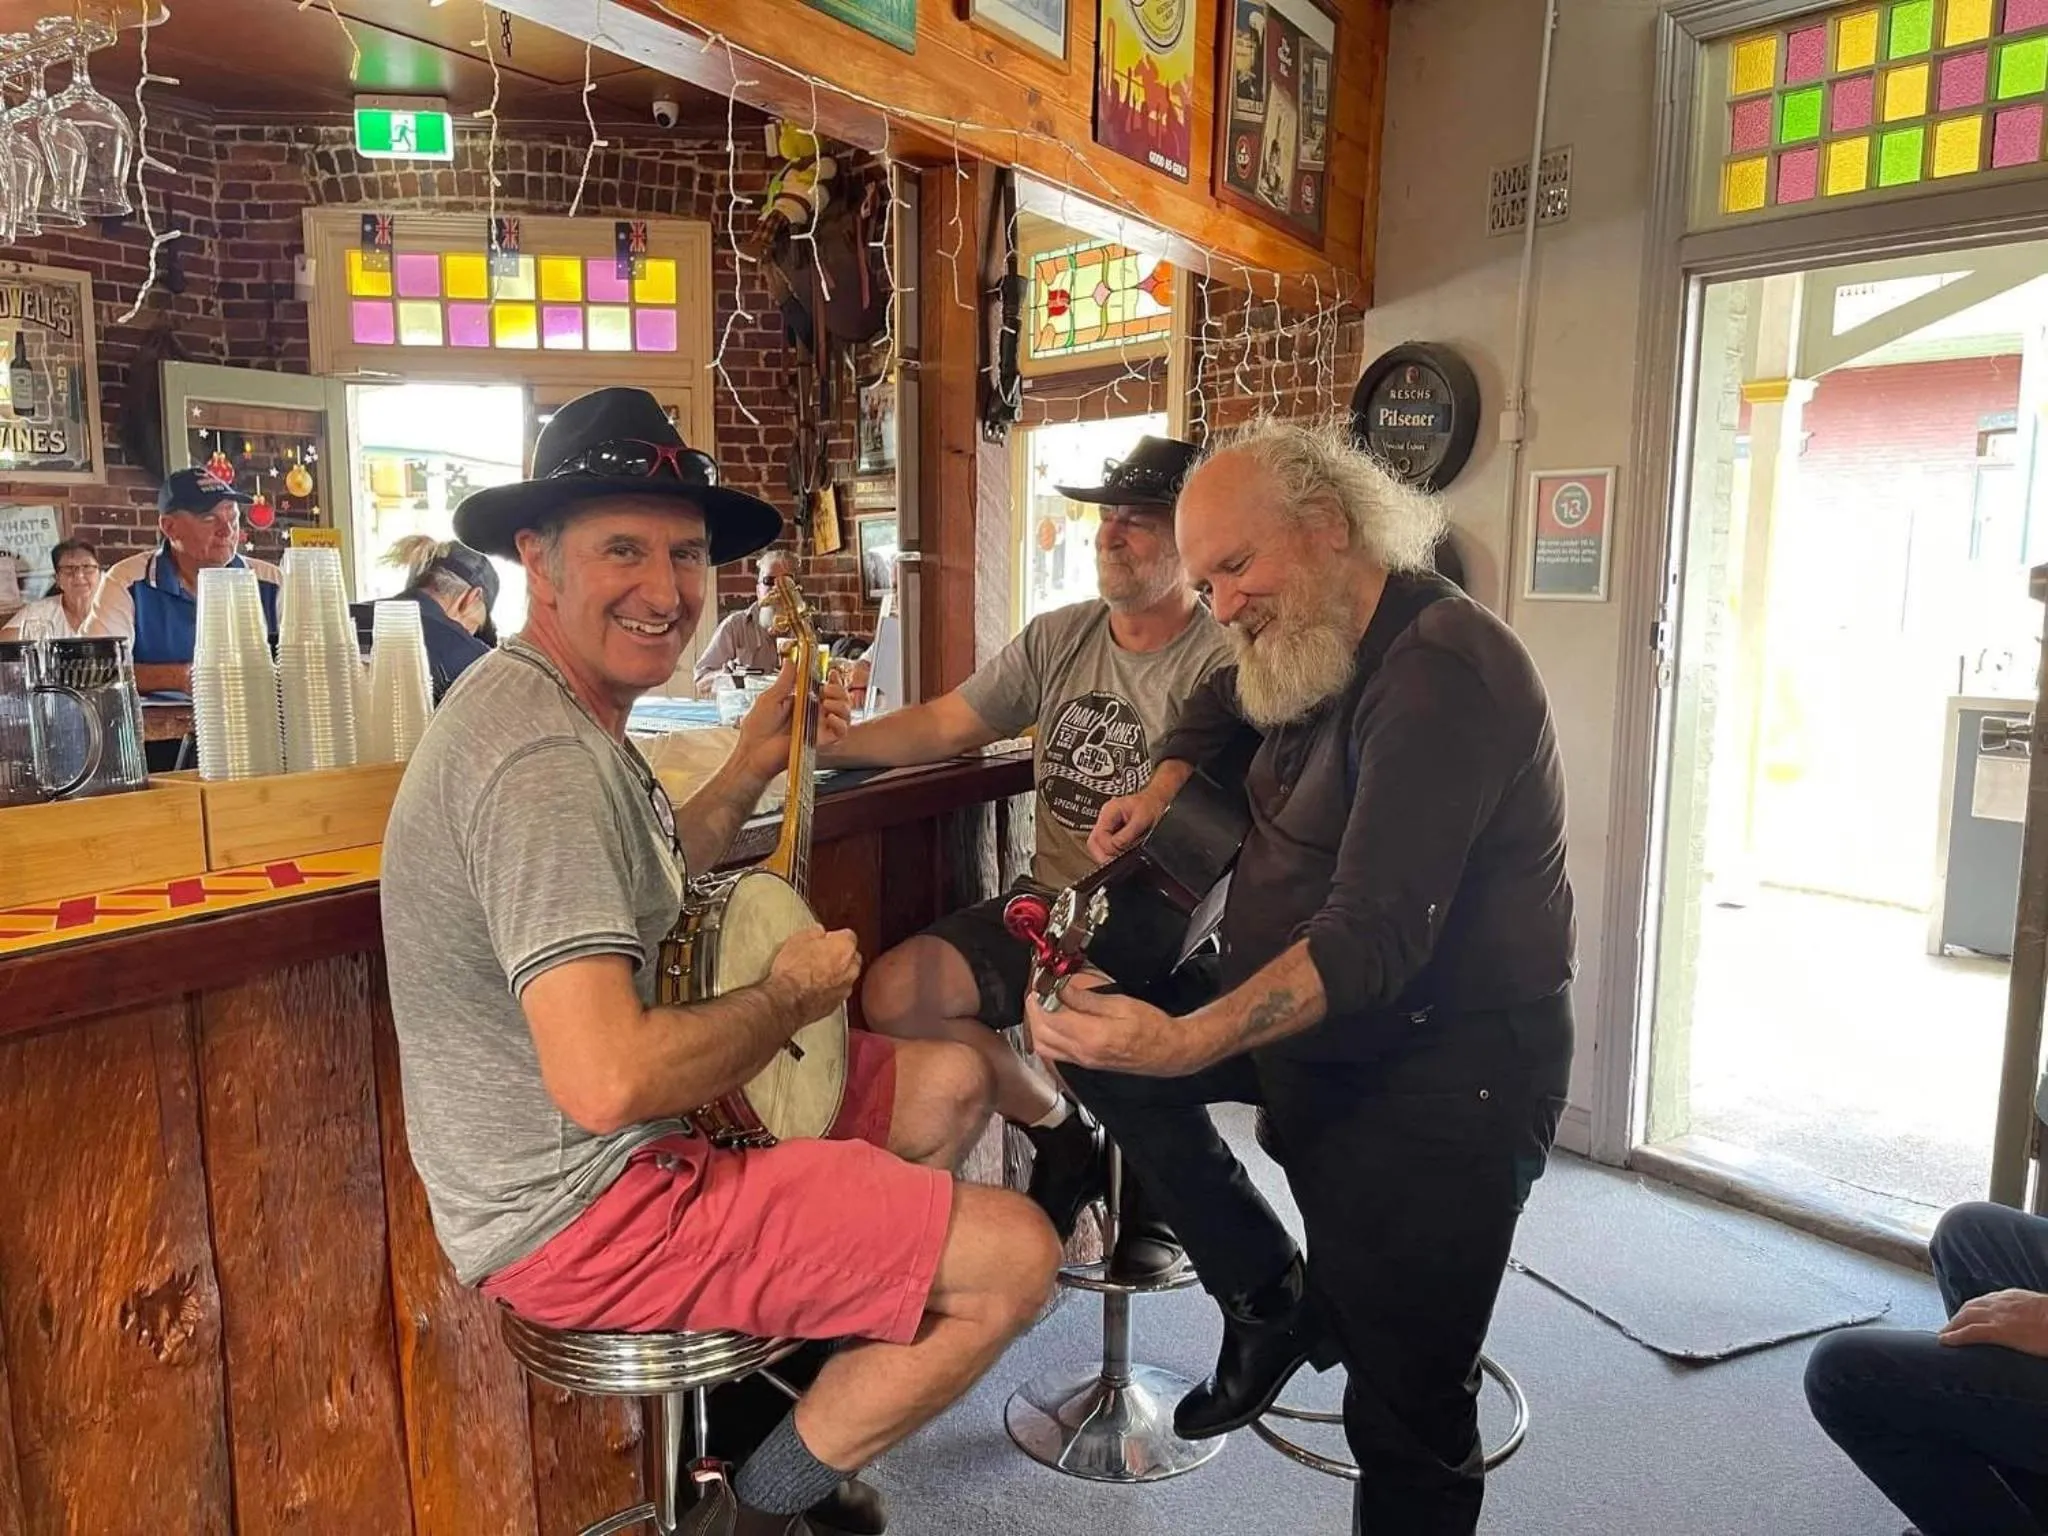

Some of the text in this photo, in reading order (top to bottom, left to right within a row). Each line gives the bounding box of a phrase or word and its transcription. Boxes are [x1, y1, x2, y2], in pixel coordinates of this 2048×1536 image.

[1389, 388, 1432, 400] RESCHS
[1379, 406, 1435, 427] Pilsener
[1046, 700, 1141, 749] JIMMY BARNES
[1053, 797, 1080, 812] SPECIAL
